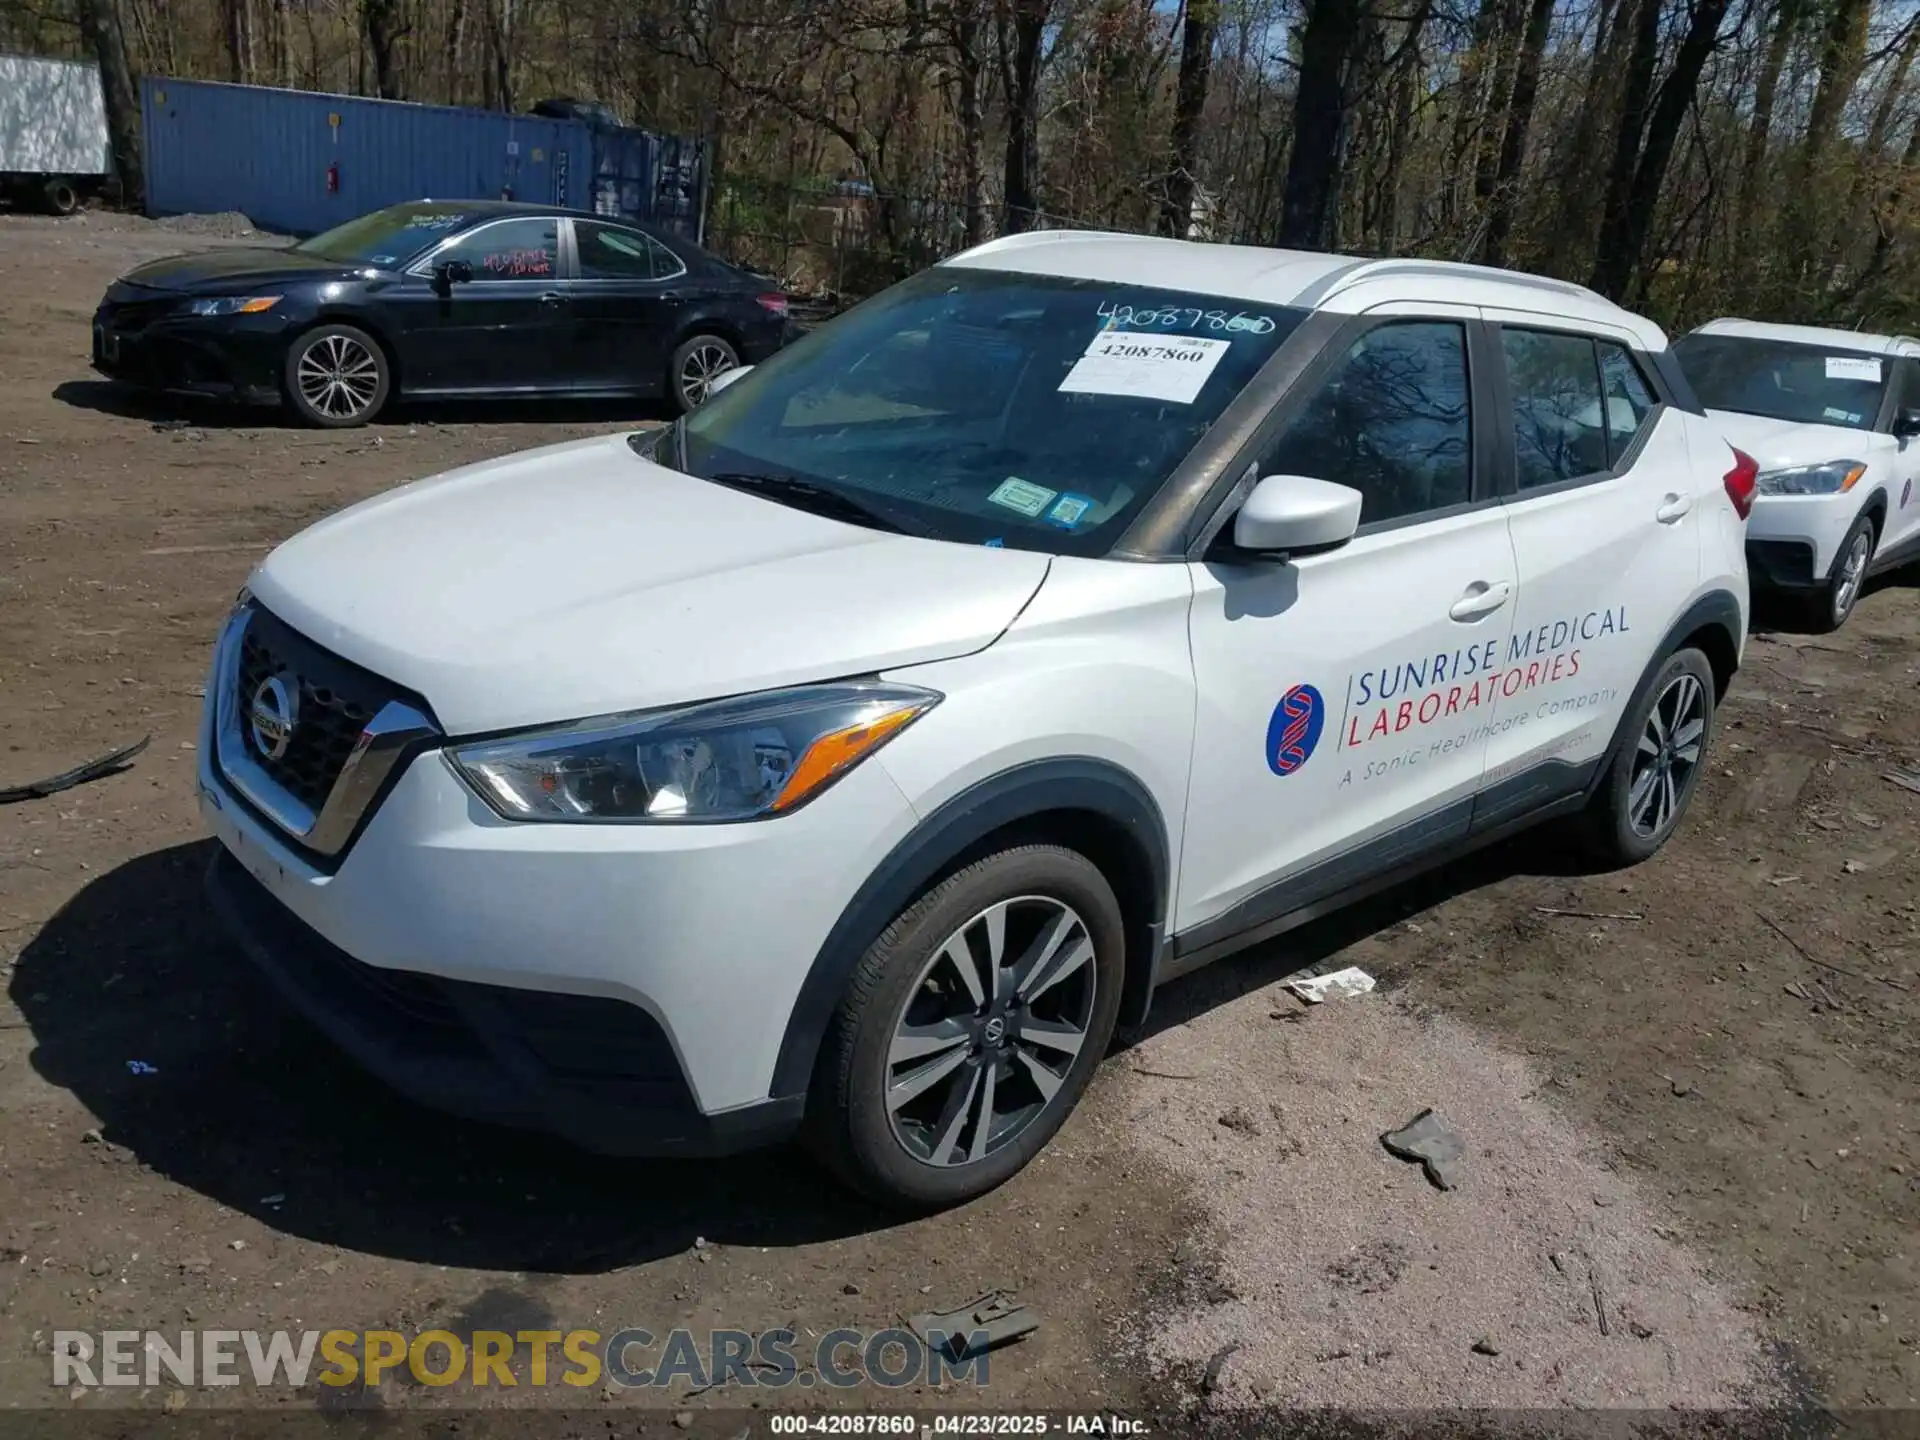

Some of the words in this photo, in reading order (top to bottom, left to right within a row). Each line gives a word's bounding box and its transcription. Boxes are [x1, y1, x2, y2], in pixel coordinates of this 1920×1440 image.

[1096, 301, 1276, 334] 42087860
[1099, 344, 1204, 363] 42087860
[1348, 650, 1582, 747] LABORATORIES
[1356, 640, 1497, 706] SUNRISE
[1507, 605, 1631, 663] MEDICAL
[1338, 769, 1352, 790] A
[1363, 750, 1420, 781] Sonic
[1429, 711, 1530, 757] Healthcare
[1536, 687, 1620, 719] Company
